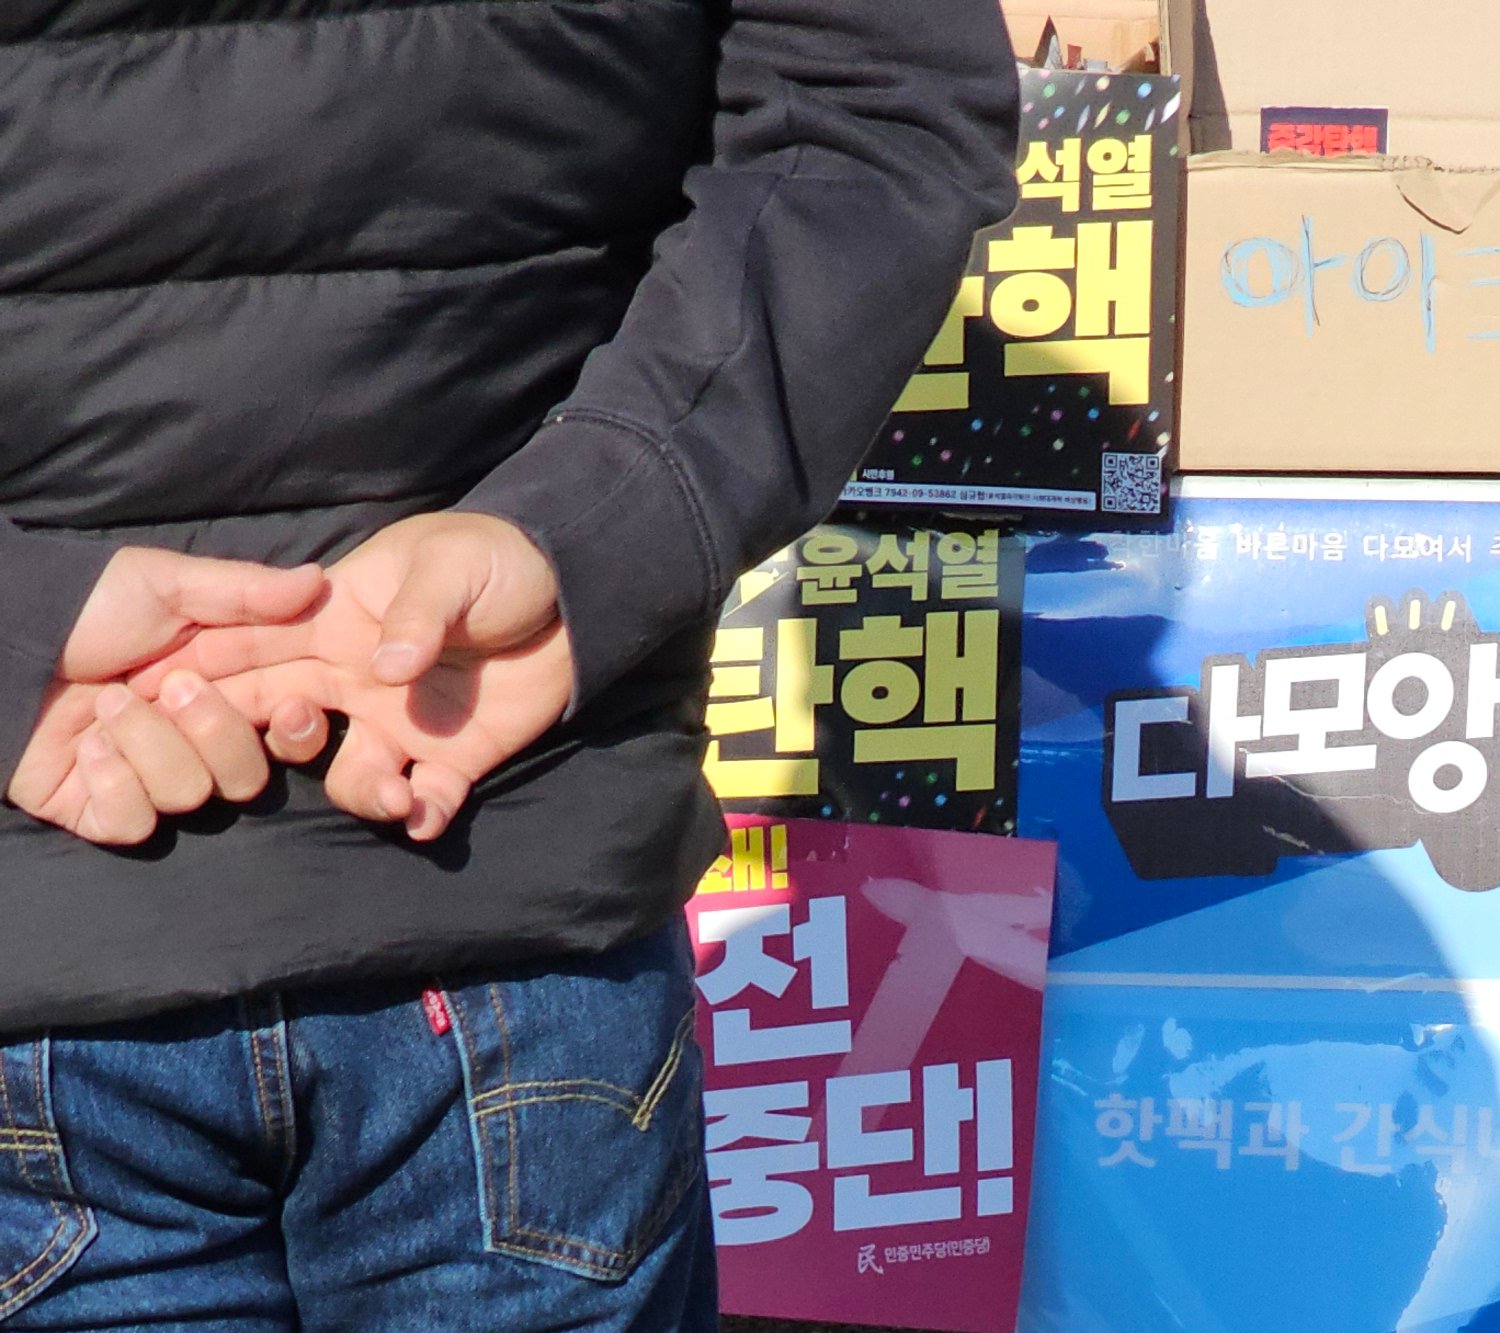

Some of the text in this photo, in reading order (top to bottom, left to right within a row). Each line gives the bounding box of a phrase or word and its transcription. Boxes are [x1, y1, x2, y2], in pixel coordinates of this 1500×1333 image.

[797, 529, 999, 606] 윤석열
[1234, 532, 1347, 561] 바른마음
[1362, 533, 1473, 563] 다모여서
[702, 609, 999, 798] 탄핵
[695, 895, 852, 1066] 전
[702, 1059, 1013, 1247] 중단!
[1093, 1092, 1309, 1173] 핫팩과
